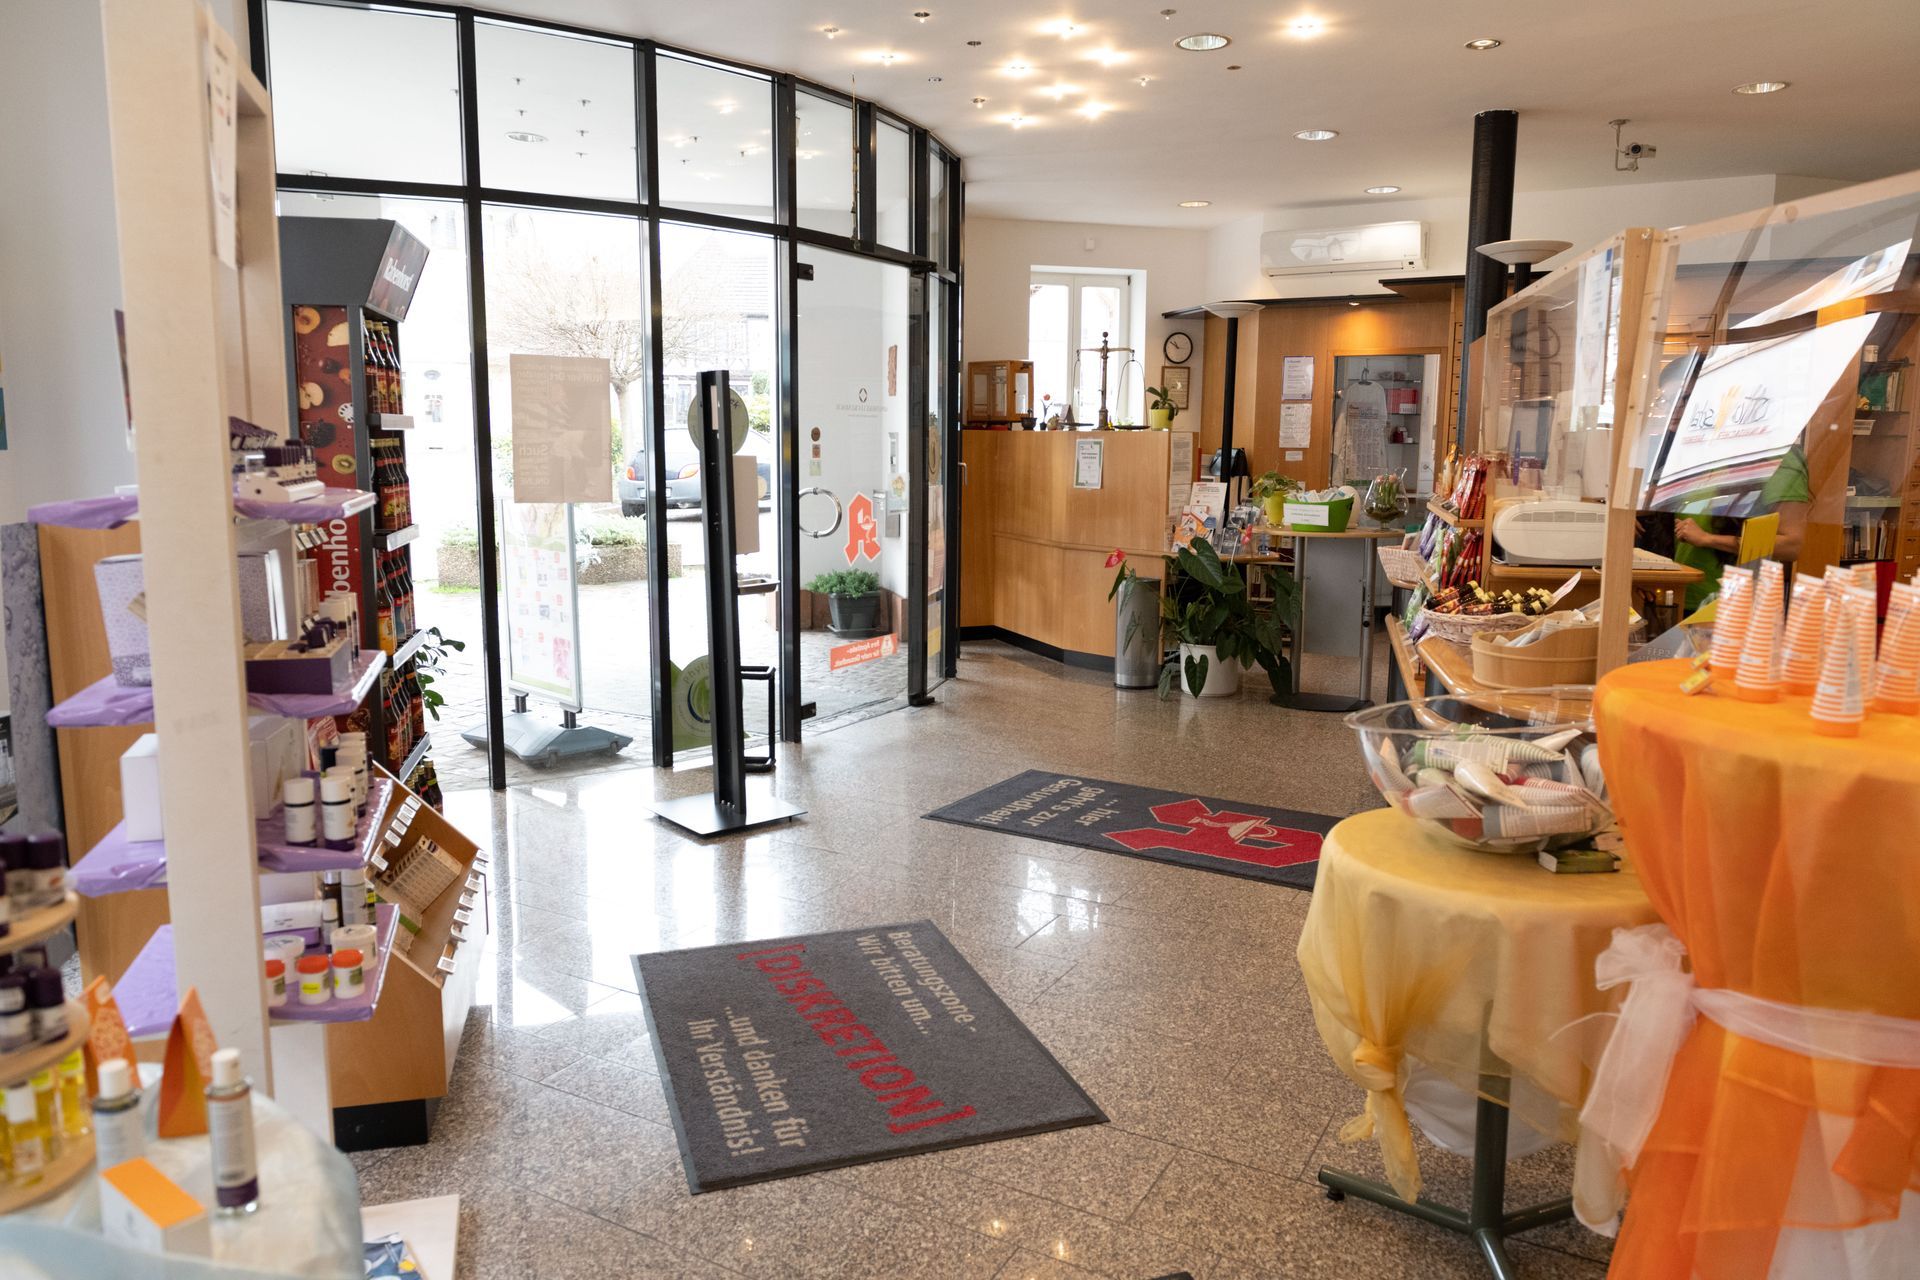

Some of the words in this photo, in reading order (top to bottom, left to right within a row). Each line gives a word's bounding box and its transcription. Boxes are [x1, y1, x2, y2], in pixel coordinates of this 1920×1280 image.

[975, 778, 1082, 825] Gesundheit!
[1052, 786, 1105, 813] geht's
[1074, 807, 1121, 827] hier
[1022, 811, 1059, 827] zur
[855, 934, 887, 955] Wir
[869, 956, 914, 997] bitten
[887, 931, 976, 1023] Beratungszone
[686, 1018, 719, 1040] Ihr
[723, 1006, 769, 1047] ...und
[901, 998, 933, 1035] um...
[696, 1040, 766, 1157] Verständnis!
[742, 1049, 790, 1114] danken
[771, 1117, 811, 1147] für
